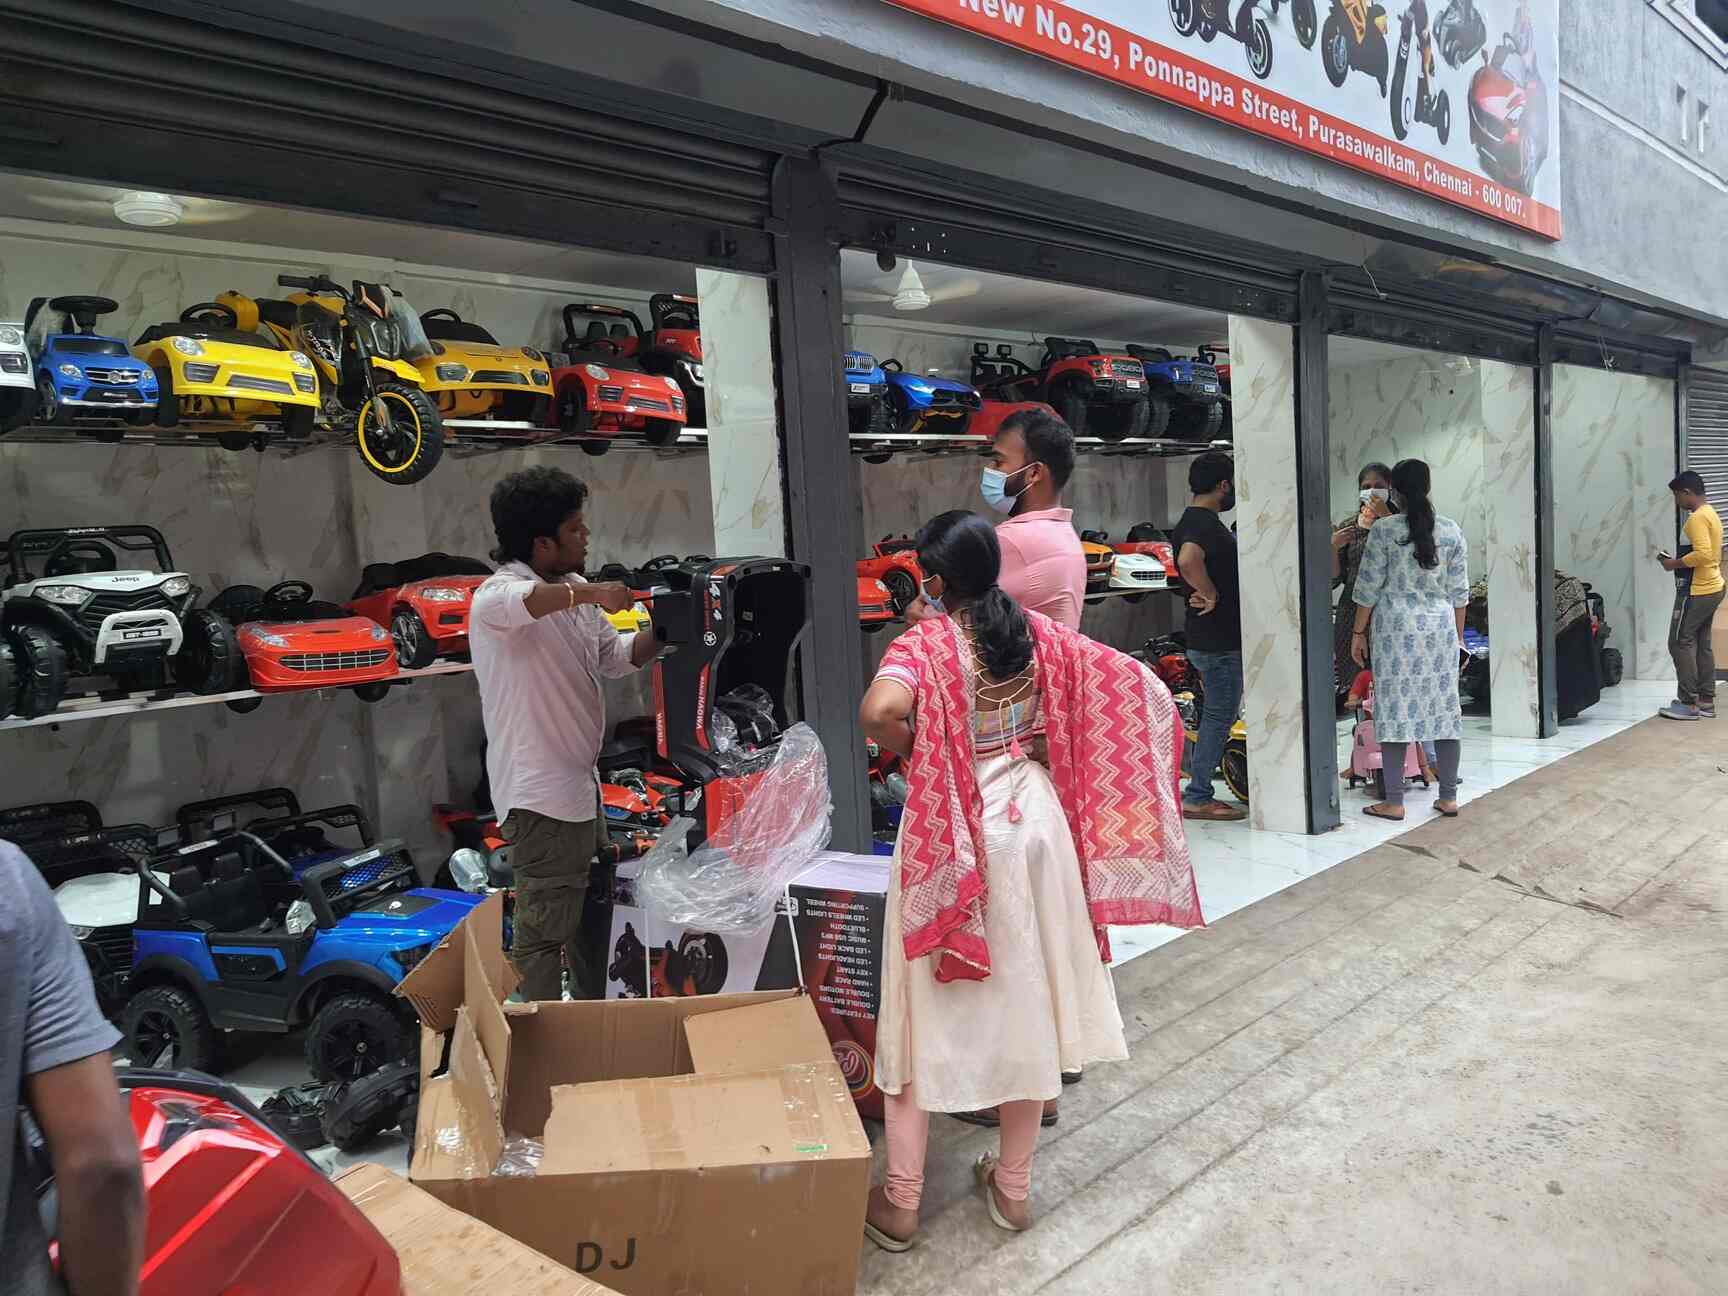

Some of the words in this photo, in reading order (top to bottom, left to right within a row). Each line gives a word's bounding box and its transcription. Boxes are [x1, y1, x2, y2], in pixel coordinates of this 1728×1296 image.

[1035, 4, 1120, 70] No.29,
[1128, 42, 1235, 107] Ponnappa
[1241, 87, 1303, 139] Street,
[1308, 114, 1420, 182] Purasawalkam,
[1423, 161, 1473, 196] Chennai
[1482, 186, 1502, 209] 600
[1504, 194, 1527, 218] 007.
[806, 898, 826, 906] WHEEL
[826, 901, 865, 911] SUPPORTING
[806, 909, 827, 918] LIGHTS
[828, 912, 853, 921] WHEELS
[853, 914, 865, 922] LED
[830, 923, 866, 932] BLUETOOTH
[817, 953, 855, 964] HEADLIGHTS
[836, 966, 855, 974] START
